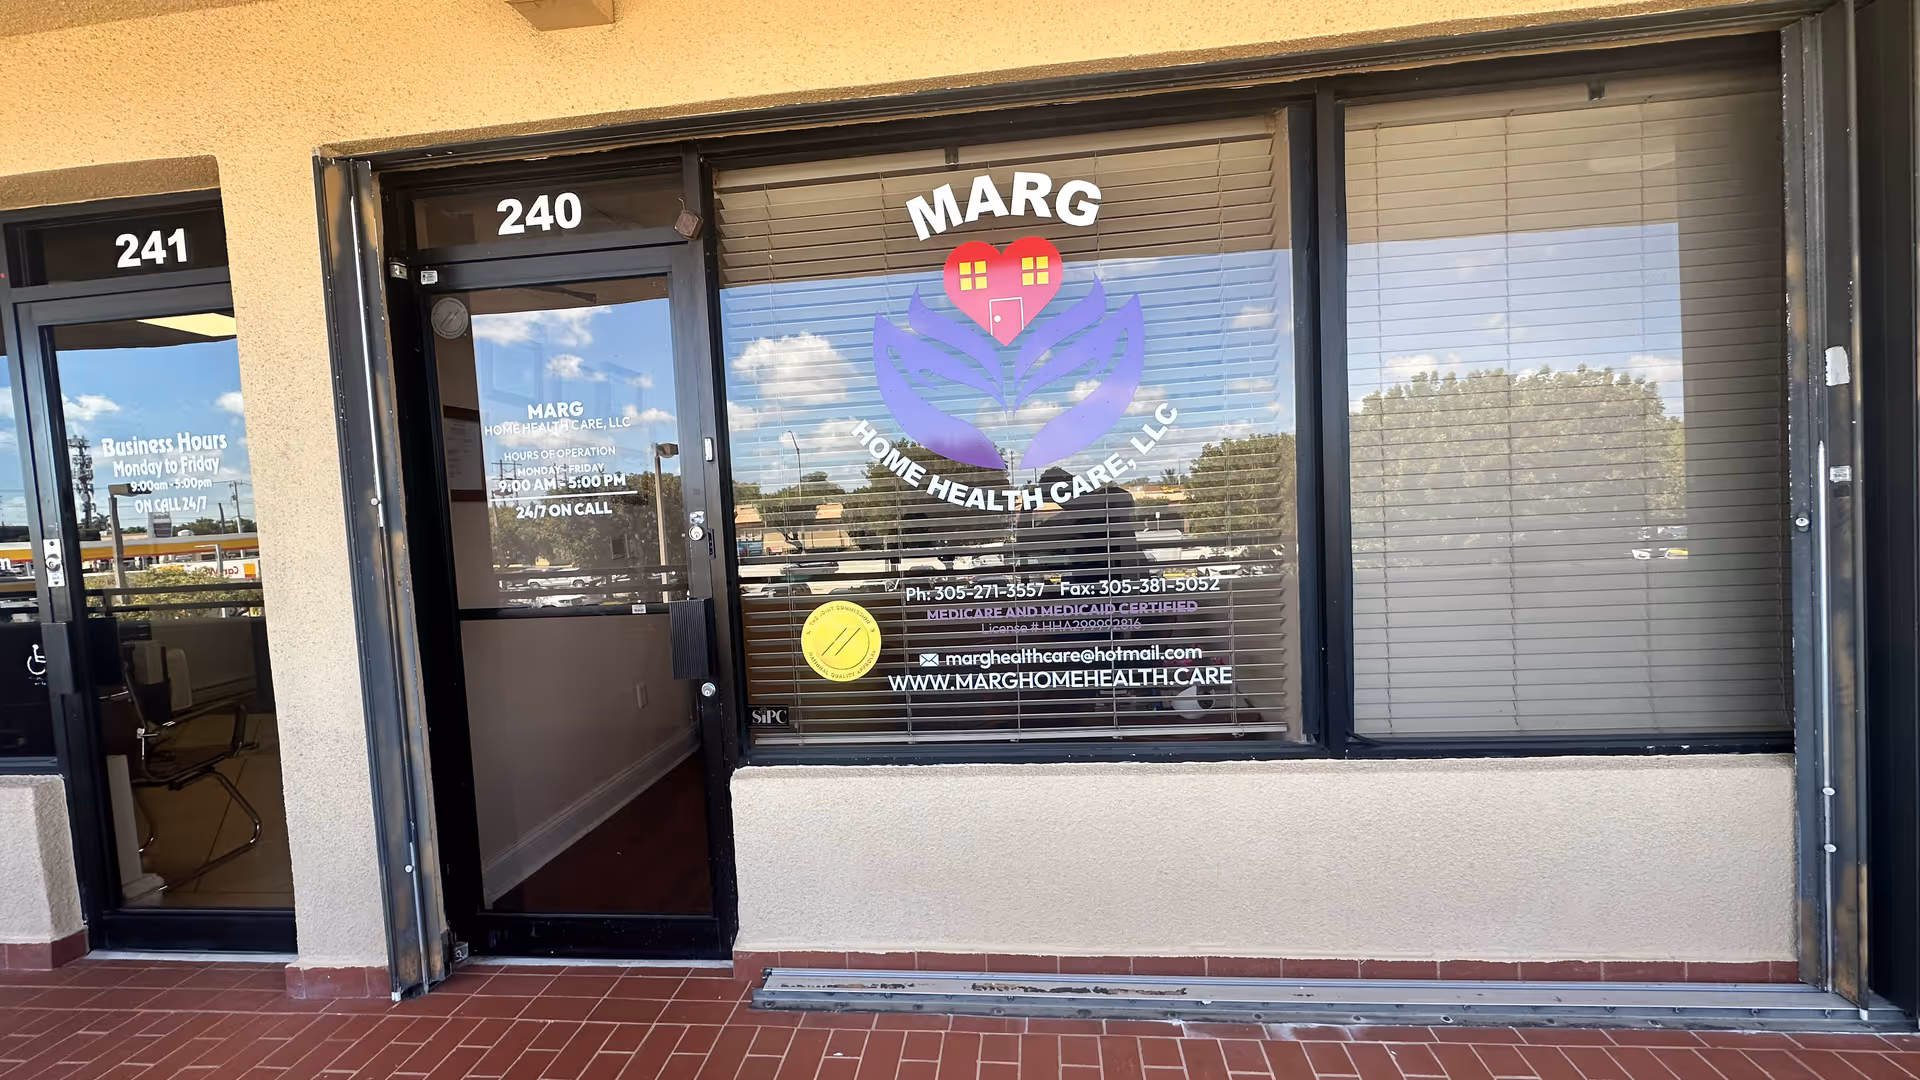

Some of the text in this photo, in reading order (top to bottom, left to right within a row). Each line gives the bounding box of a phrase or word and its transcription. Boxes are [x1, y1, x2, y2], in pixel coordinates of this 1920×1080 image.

[496, 192, 582, 235] 240
[906, 171, 1102, 241] MARG
[115, 228, 187, 268] 241
[527, 401, 584, 419] MARG
[484, 416, 631, 436] HOME HEALTH CARE, LLC
[101, 432, 228, 457] Business Hours
[504, 446, 616, 461] HOURS OF OPERATION
[113, 455, 220, 478] Monday to Friday
[851, 402, 1178, 511] HOME HEALTH CARE, LLC
[517, 465, 560, 476] MONDAY
[569, 463, 604, 473] FRIDAY
[130, 481, 168, 493] 9:00am
[175, 478, 212, 490] 5:00pm
[499, 480, 531, 493] 9:00
[533, 478, 556, 491] AM
[568, 475, 601, 488] 5:00
[604, 473, 626, 486] PM
[135, 495, 207, 513] ON CALL 24/7
[515, 501, 612, 519] 24/7 ON CALL
[906, 577, 1220, 601] Ph: 305-271-3557 Fax: 305-381-5052
[926, 601, 1198, 620] MEDICARE AND MEDICAID CERTIFIED
[981, 623, 1027, 634] License
[1030, 622, 1039, 632] #
[946, 645, 1202, 669] marghealthcare@hotmail.com
[888, 667, 1233, 691] WWW.MARGHOMEHEALTH.CARE
